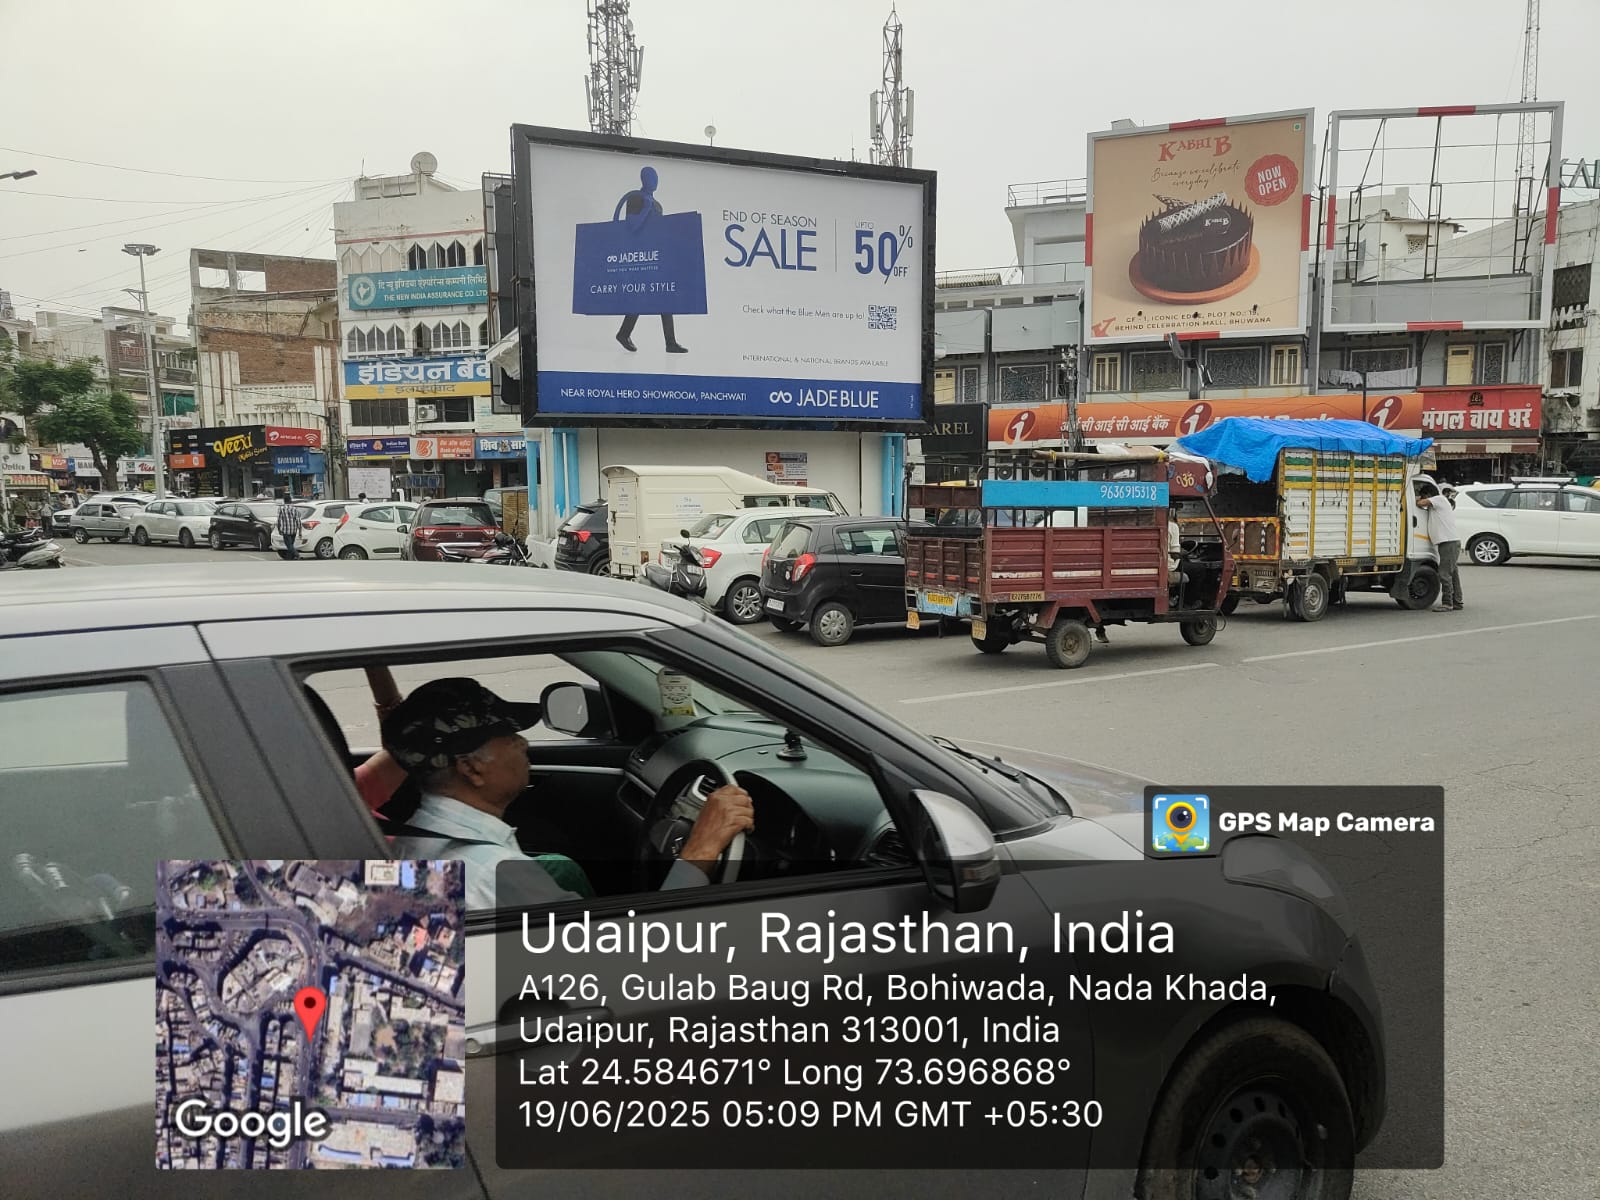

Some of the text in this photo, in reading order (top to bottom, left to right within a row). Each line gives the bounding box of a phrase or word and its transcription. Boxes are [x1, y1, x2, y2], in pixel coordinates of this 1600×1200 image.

[1158, 135, 1232, 162] KABHI B
[1257, 165, 1282, 183] NOW
[1258, 177, 1287, 196] OPEN
[723, 210, 817, 228] END OF SEASON
[724, 224, 817, 271] SALE
[893, 267, 908, 277] OFF
[590, 282, 676, 294] CARRY YOUR STYLE
[384, 294, 395, 302] THE
[397, 293, 410, 301] NEW
[411, 292, 427, 300] INDIA
[428, 291, 464, 299] ASSURANCE
[742, 305, 764, 314] Check
[767, 306, 784, 315] what
[786, 306, 796, 316] the
[798, 307, 814, 317] Blue
[815, 310, 830, 318] Men
[1147, 321, 1200, 329] CELEBRATION
[1229, 317, 1271, 325] BHUWANA
[742, 354, 792, 363] INTERNATIONAL
[800, 357, 833, 365] NATIONAL
[834, 358, 859, 366] BRANDS
[358, 361, 455, 385] इंडियन
[560, 388, 747, 402] NEAR ROYAL HERO SHOWROOM, PANCHWATI
[1082, 416, 1094, 431] सी
[1095, 416, 1115, 433] आई
[1116, 416, 1129, 431] सी
[1130, 415, 1152, 432] आई
[1152, 414, 1171, 430] बैंक
[1422, 408, 1466, 430] मंगल
[1470, 409, 1504, 429] चाय
[480, 439, 498, 451] शिव
[277, 456, 303, 464] SAMSUNG
[1101, 485, 1157, 500] 9636915318
